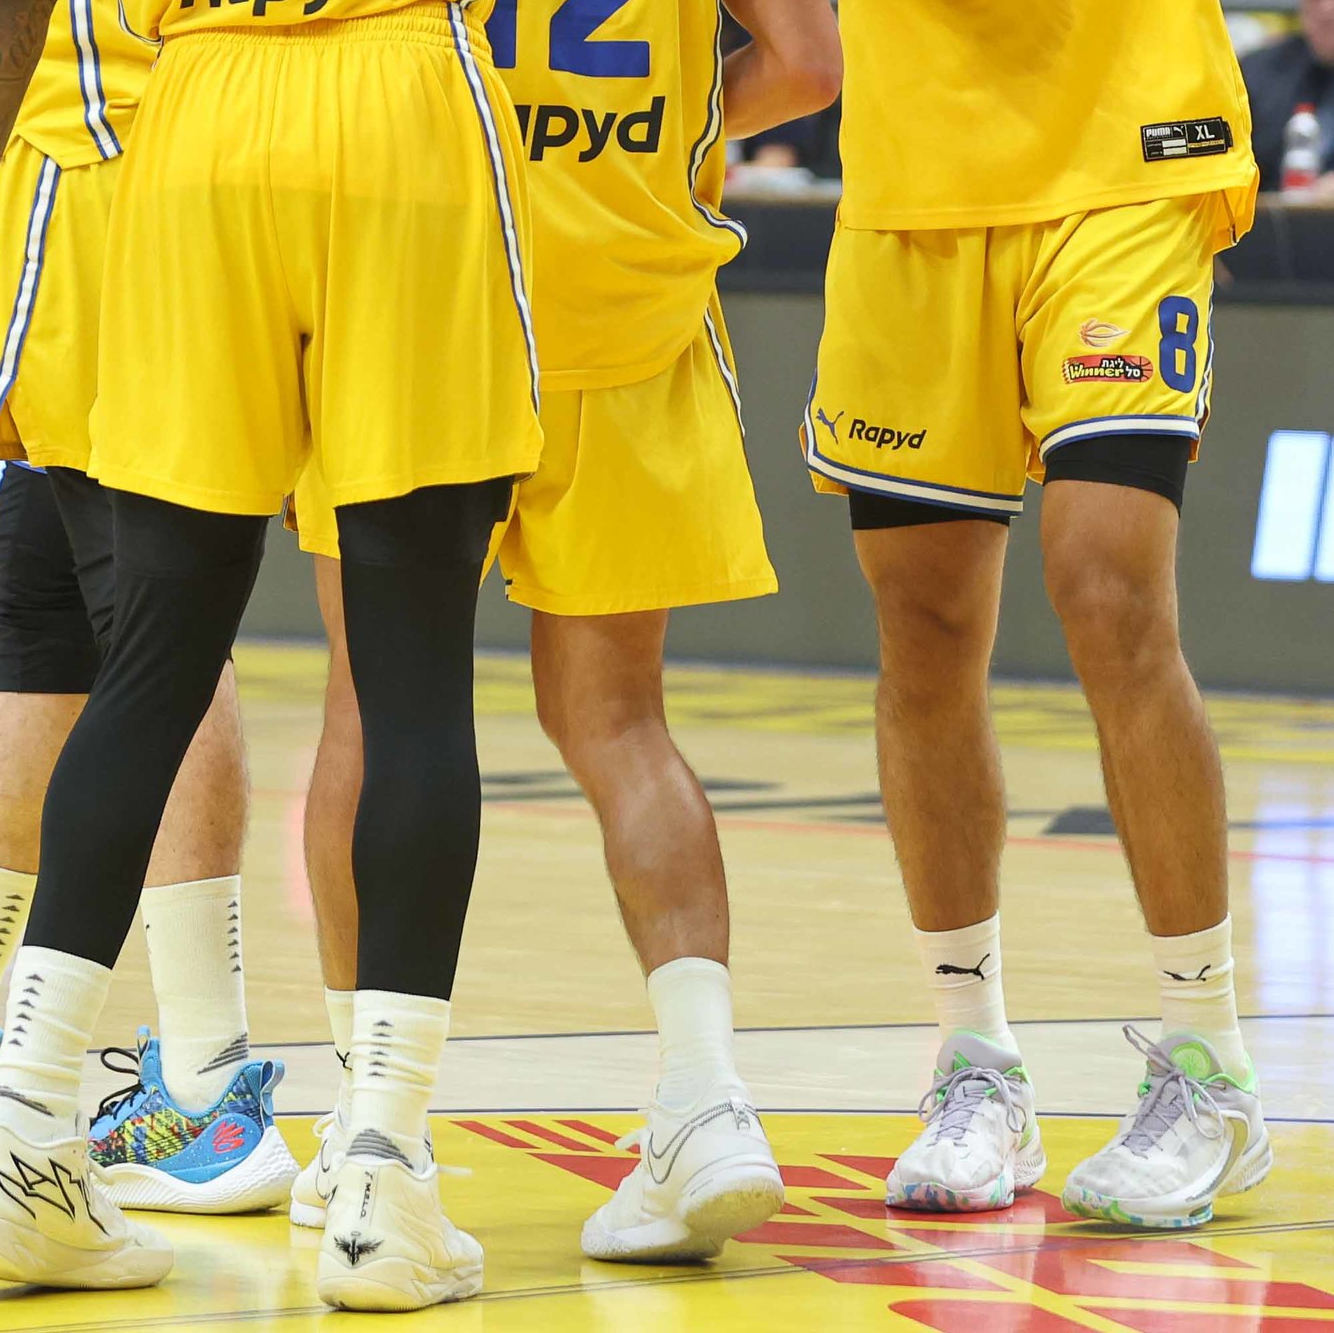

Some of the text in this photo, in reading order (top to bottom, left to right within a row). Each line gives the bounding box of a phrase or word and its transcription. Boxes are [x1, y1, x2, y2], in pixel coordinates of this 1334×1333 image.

[514, 96, 666, 163] pyd
[1194, 124, 1216, 141] XL
[1158, 295, 1199, 394] 8
[848, 418, 927, 450] Rapyd
